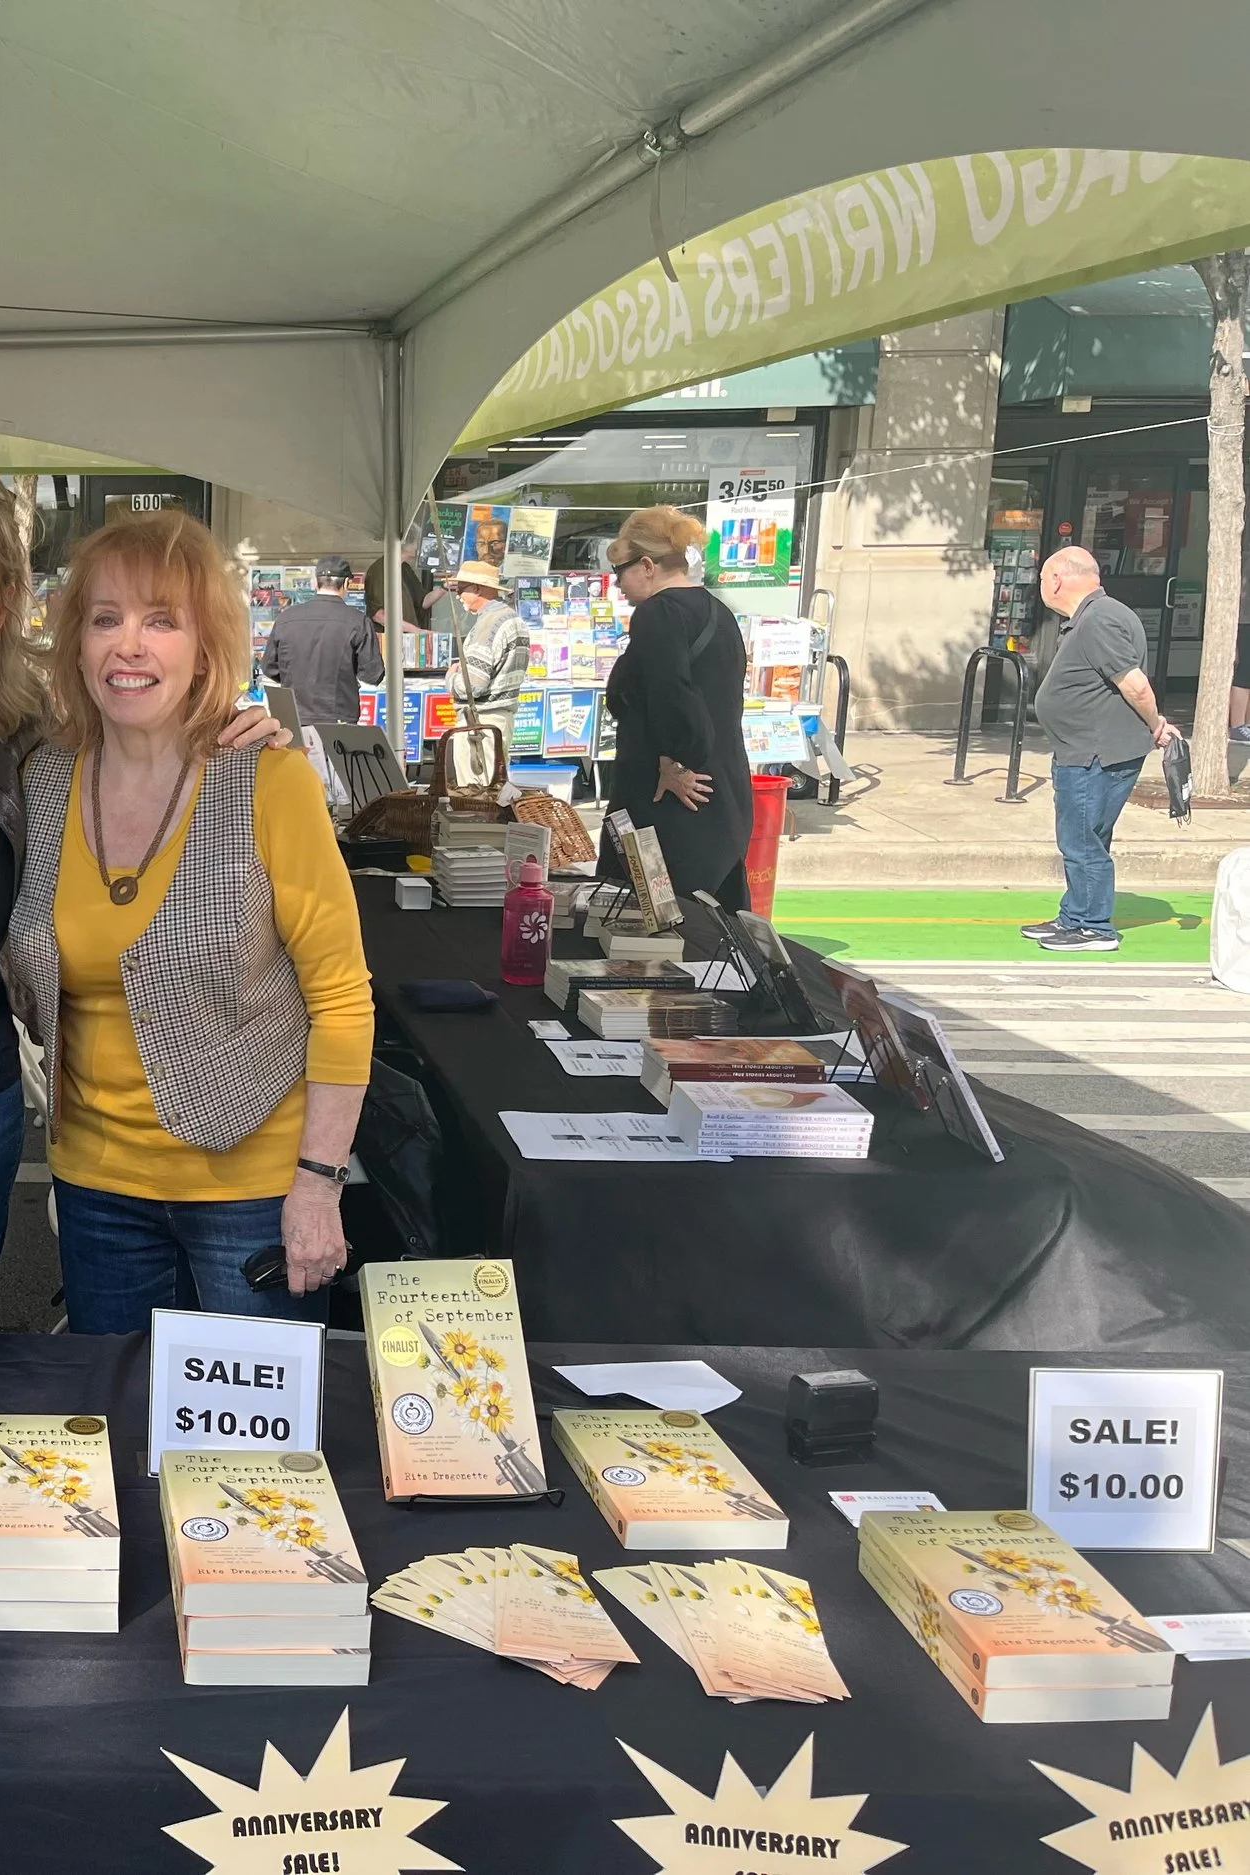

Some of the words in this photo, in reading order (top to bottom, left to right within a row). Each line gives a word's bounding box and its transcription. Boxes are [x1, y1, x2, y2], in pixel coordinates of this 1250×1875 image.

[133, 494, 160, 510] 600
[386, 1273, 421, 1287] The
[377, 1289, 481, 1305] Fourteenth
[394, 1309, 414, 1323] of
[424, 1308, 514, 1324] September
[382, 1339, 419, 1355] FINALIST
[183, 1356, 286, 1391] SALE!
[175, 1405, 291, 1441] $10.00
[578, 1414, 611, 1422] The
[571, 1422, 675, 1431] Fourteenth
[1068, 1417, 1180, 1446] SALE!
[7, 1437, 104, 1449] September
[592, 1430, 612, 1439] of
[622, 1430, 712, 1441] September
[185, 1454, 223, 1465] The
[174, 1463, 289, 1475] Fourteenth
[191, 1474, 213, 1485] of
[225, 1474, 327, 1487] September
[403, 1471, 430, 1482] Rita
[433, 1471, 490, 1484] Dragonette
[1058, 1471, 1185, 1502] $10.00
[891, 1515, 934, 1526] The
[887, 1525, 1011, 1537] Fourteenth
[916, 1536, 941, 1548] of
[951, 1535, 1060, 1549] September
[231, 1807, 385, 1838] ANNIVERSARY
[684, 1822, 842, 1860] ANNIVERSARY
[282, 1851, 341, 1875] SALE!
[1164, 1846, 1223, 1875] SALE!
